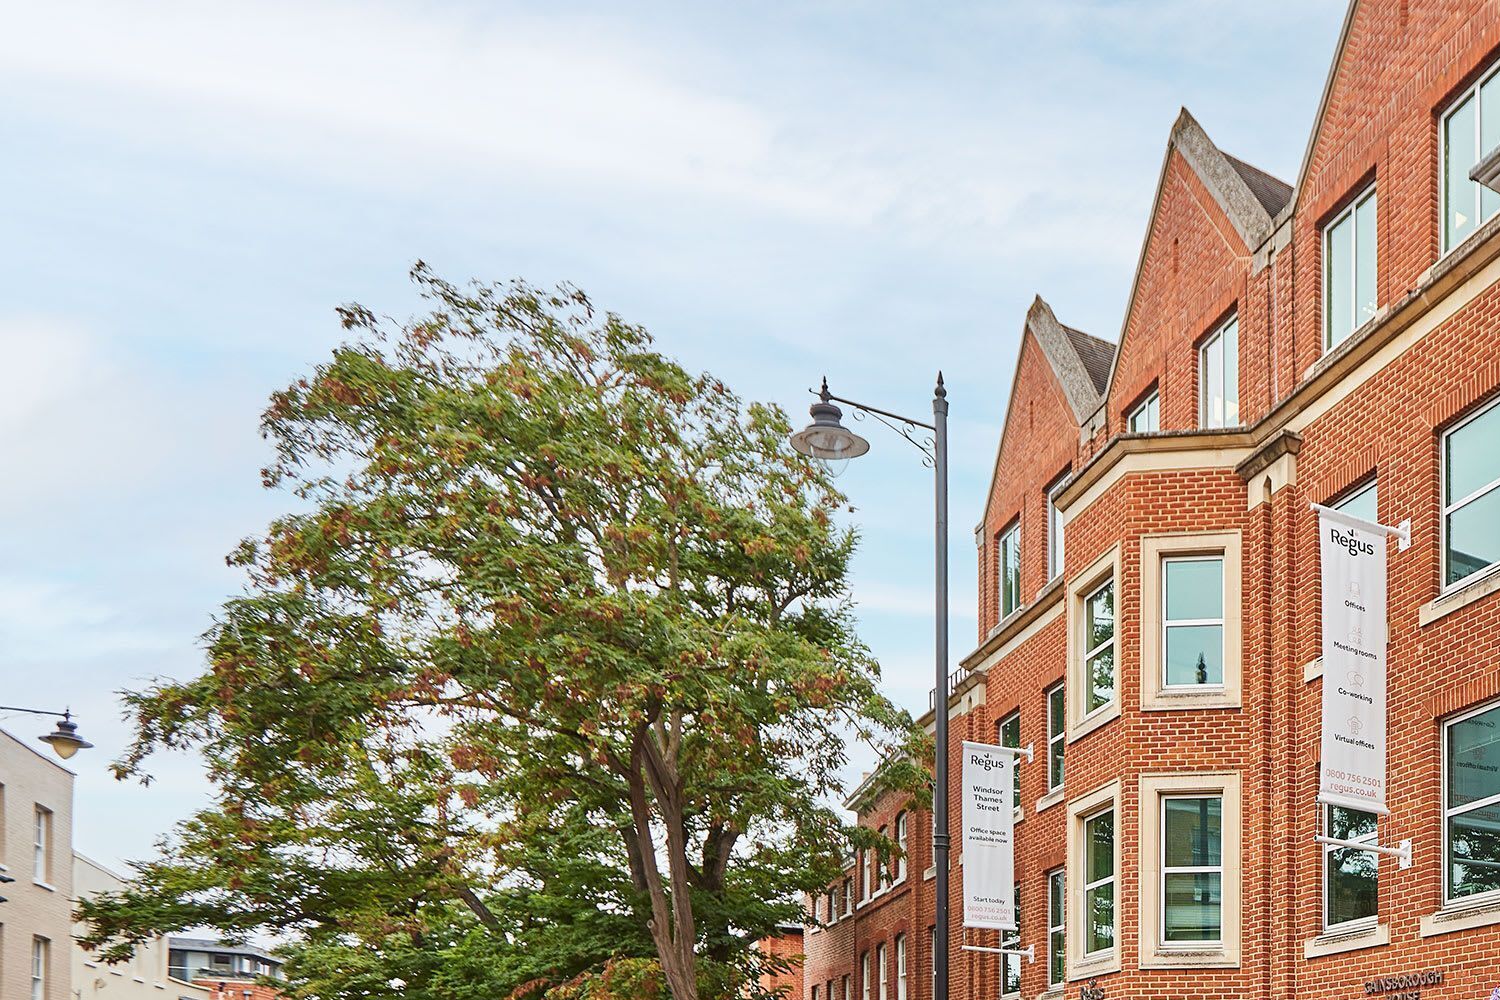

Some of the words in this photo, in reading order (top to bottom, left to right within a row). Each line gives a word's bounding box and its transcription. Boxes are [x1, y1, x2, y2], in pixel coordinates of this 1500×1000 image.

[1331, 529, 1374, 556] Regus
[1344, 600, 1366, 612] Offices
[1333, 641, 1358, 655] Meeting
[1359, 650, 1377, 660] rooms
[1337, 687, 1373, 704] Co-working
[1334, 733, 1355, 745] Virtual
[1355, 740, 1375, 750] offices
[970, 754, 1004, 771] Regus
[1325, 768, 1346, 780] 0800
[1347, 773, 1361, 784] 756
[1362, 776, 1381, 788] 2501
[972, 785, 1003, 795] Windsor
[1330, 782, 1377, 798] regus.co.uk
[974, 794, 1003, 804] Thames
[976, 803, 1000, 812] Street
[970, 826, 989, 834] Office
[969, 835, 994, 843] available
[973, 895, 988, 903] Start
[1364, 971, 1445, 995] GAINSBOROUGH
